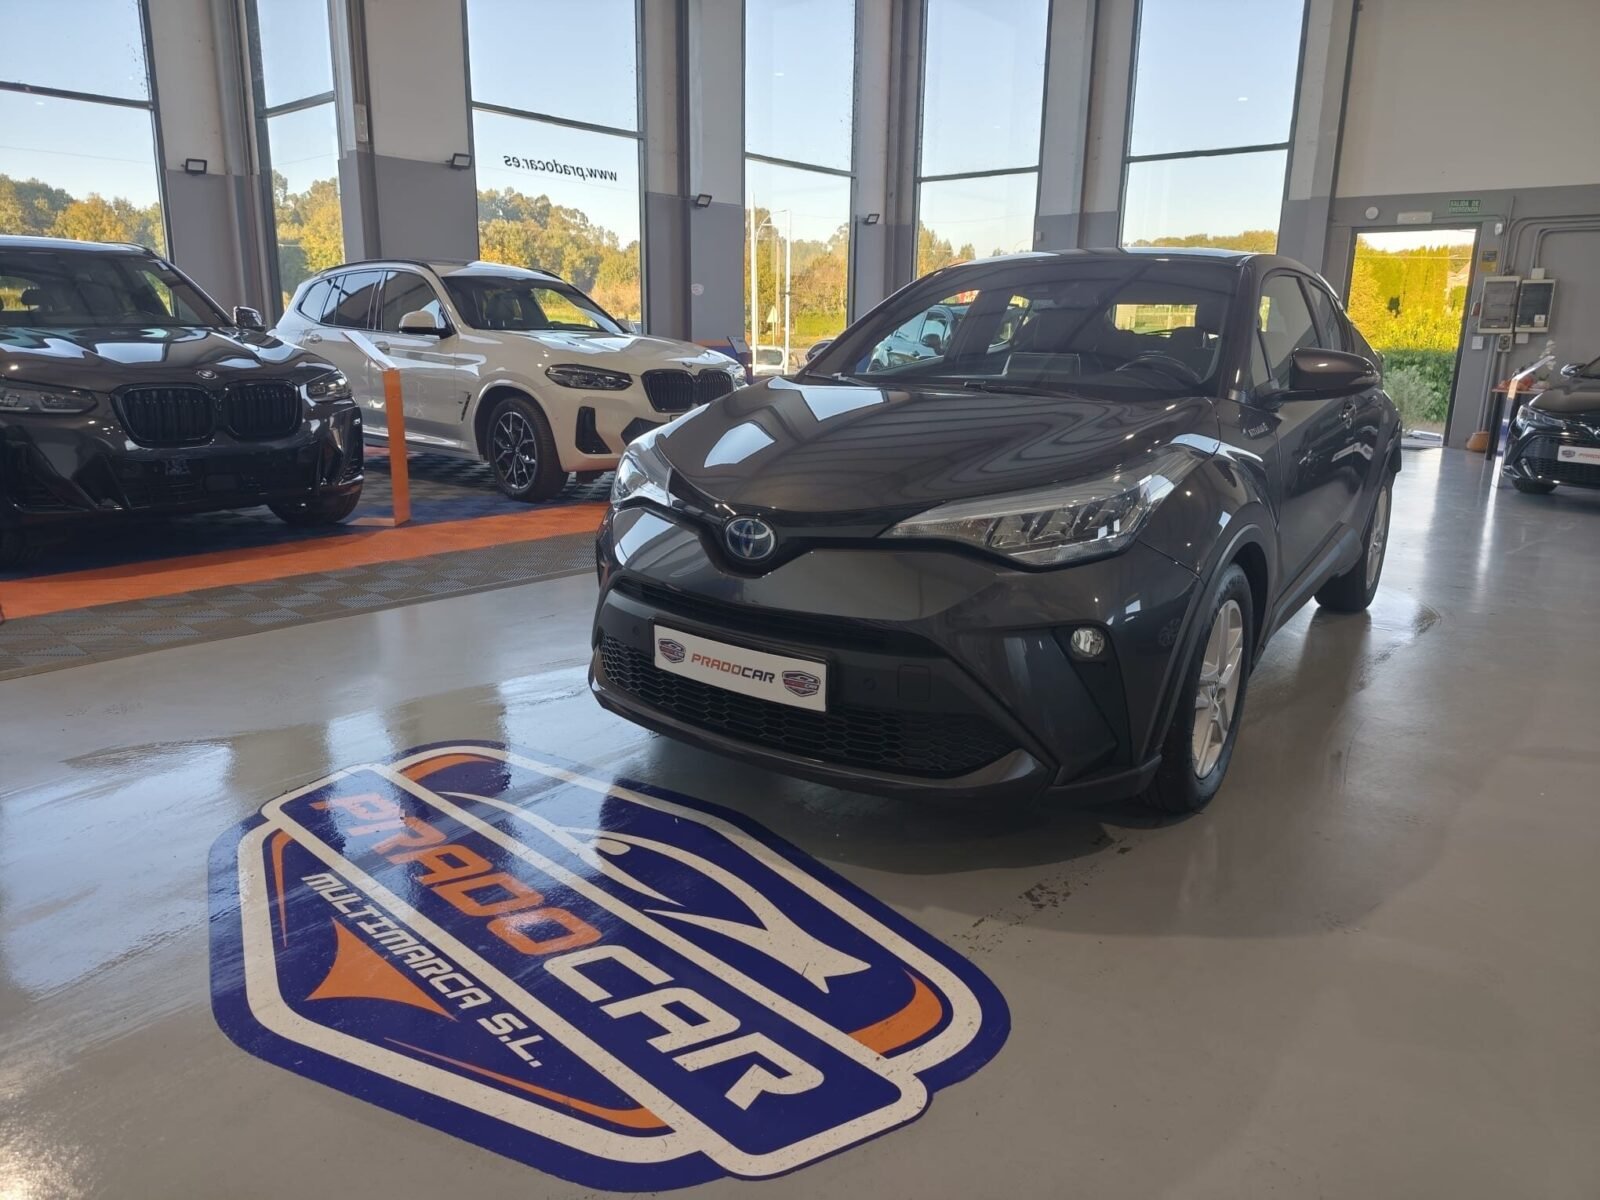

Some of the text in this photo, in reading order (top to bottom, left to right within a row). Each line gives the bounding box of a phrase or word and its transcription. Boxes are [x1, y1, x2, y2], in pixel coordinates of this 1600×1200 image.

[691, 653, 775, 683] PRADOCAR
[301, 872, 543, 1068] MULTIMARCA S.L.
[309, 793, 824, 1111] PRADOCAR
